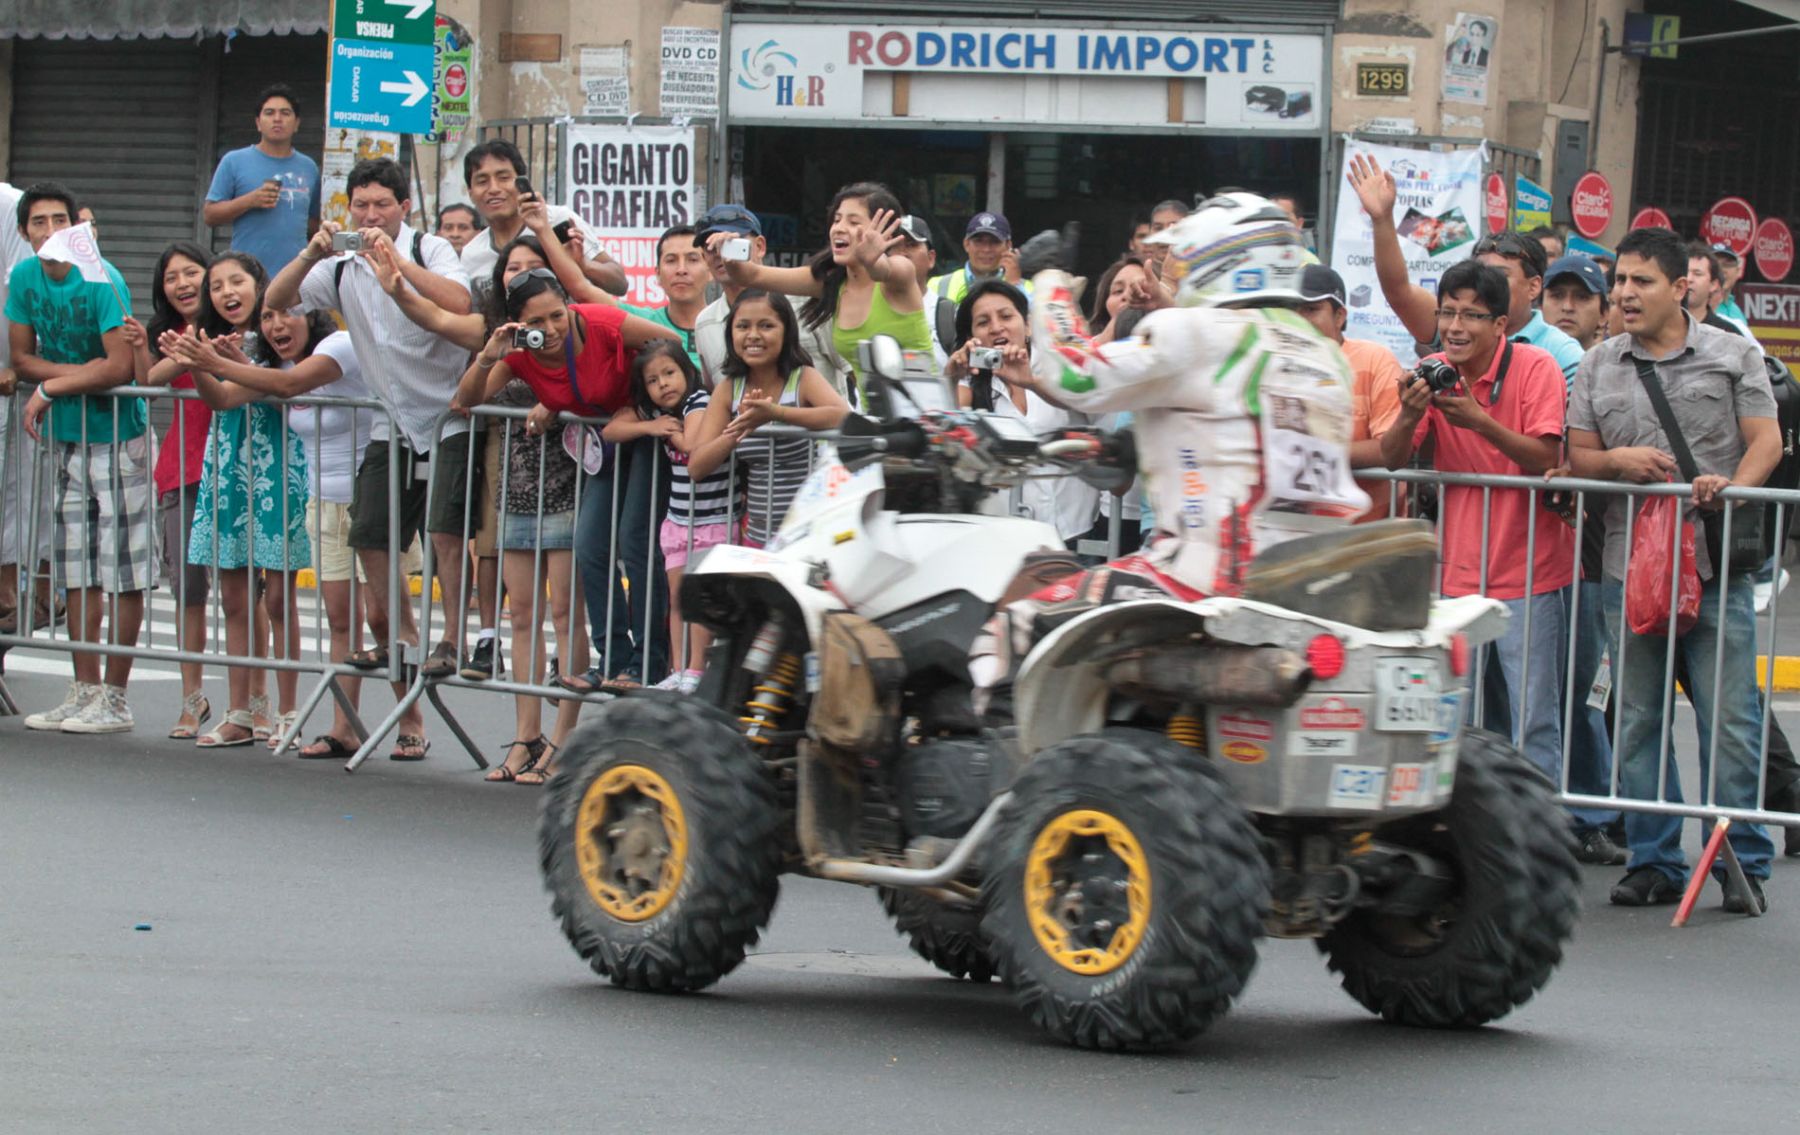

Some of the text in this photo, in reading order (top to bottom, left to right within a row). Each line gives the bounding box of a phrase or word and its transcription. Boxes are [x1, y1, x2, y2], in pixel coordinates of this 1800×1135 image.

[355, 20, 395, 39] PRENSA
[337, 43, 394, 60] Organización
[662, 47, 717, 60] DVD CD
[849, 31, 1255, 73] RODRICH IMPORT
[351, 66, 361, 103] DAKAR
[678, 72, 715, 83] NECESITA
[1361, 71, 1404, 89] 1299
[776, 75, 825, 106] H&R
[333, 111, 390, 126] Organización
[572, 142, 688, 187] GIGANTO
[1577, 191, 1604, 206] Claro
[573, 189, 688, 228] GRAFIAS
[1576, 204, 1609, 217] RECARGA
[1710, 214, 1751, 231] RECARGA
[1759, 236, 1784, 250] Claro
[1744, 292, 1800, 321] NEXT
